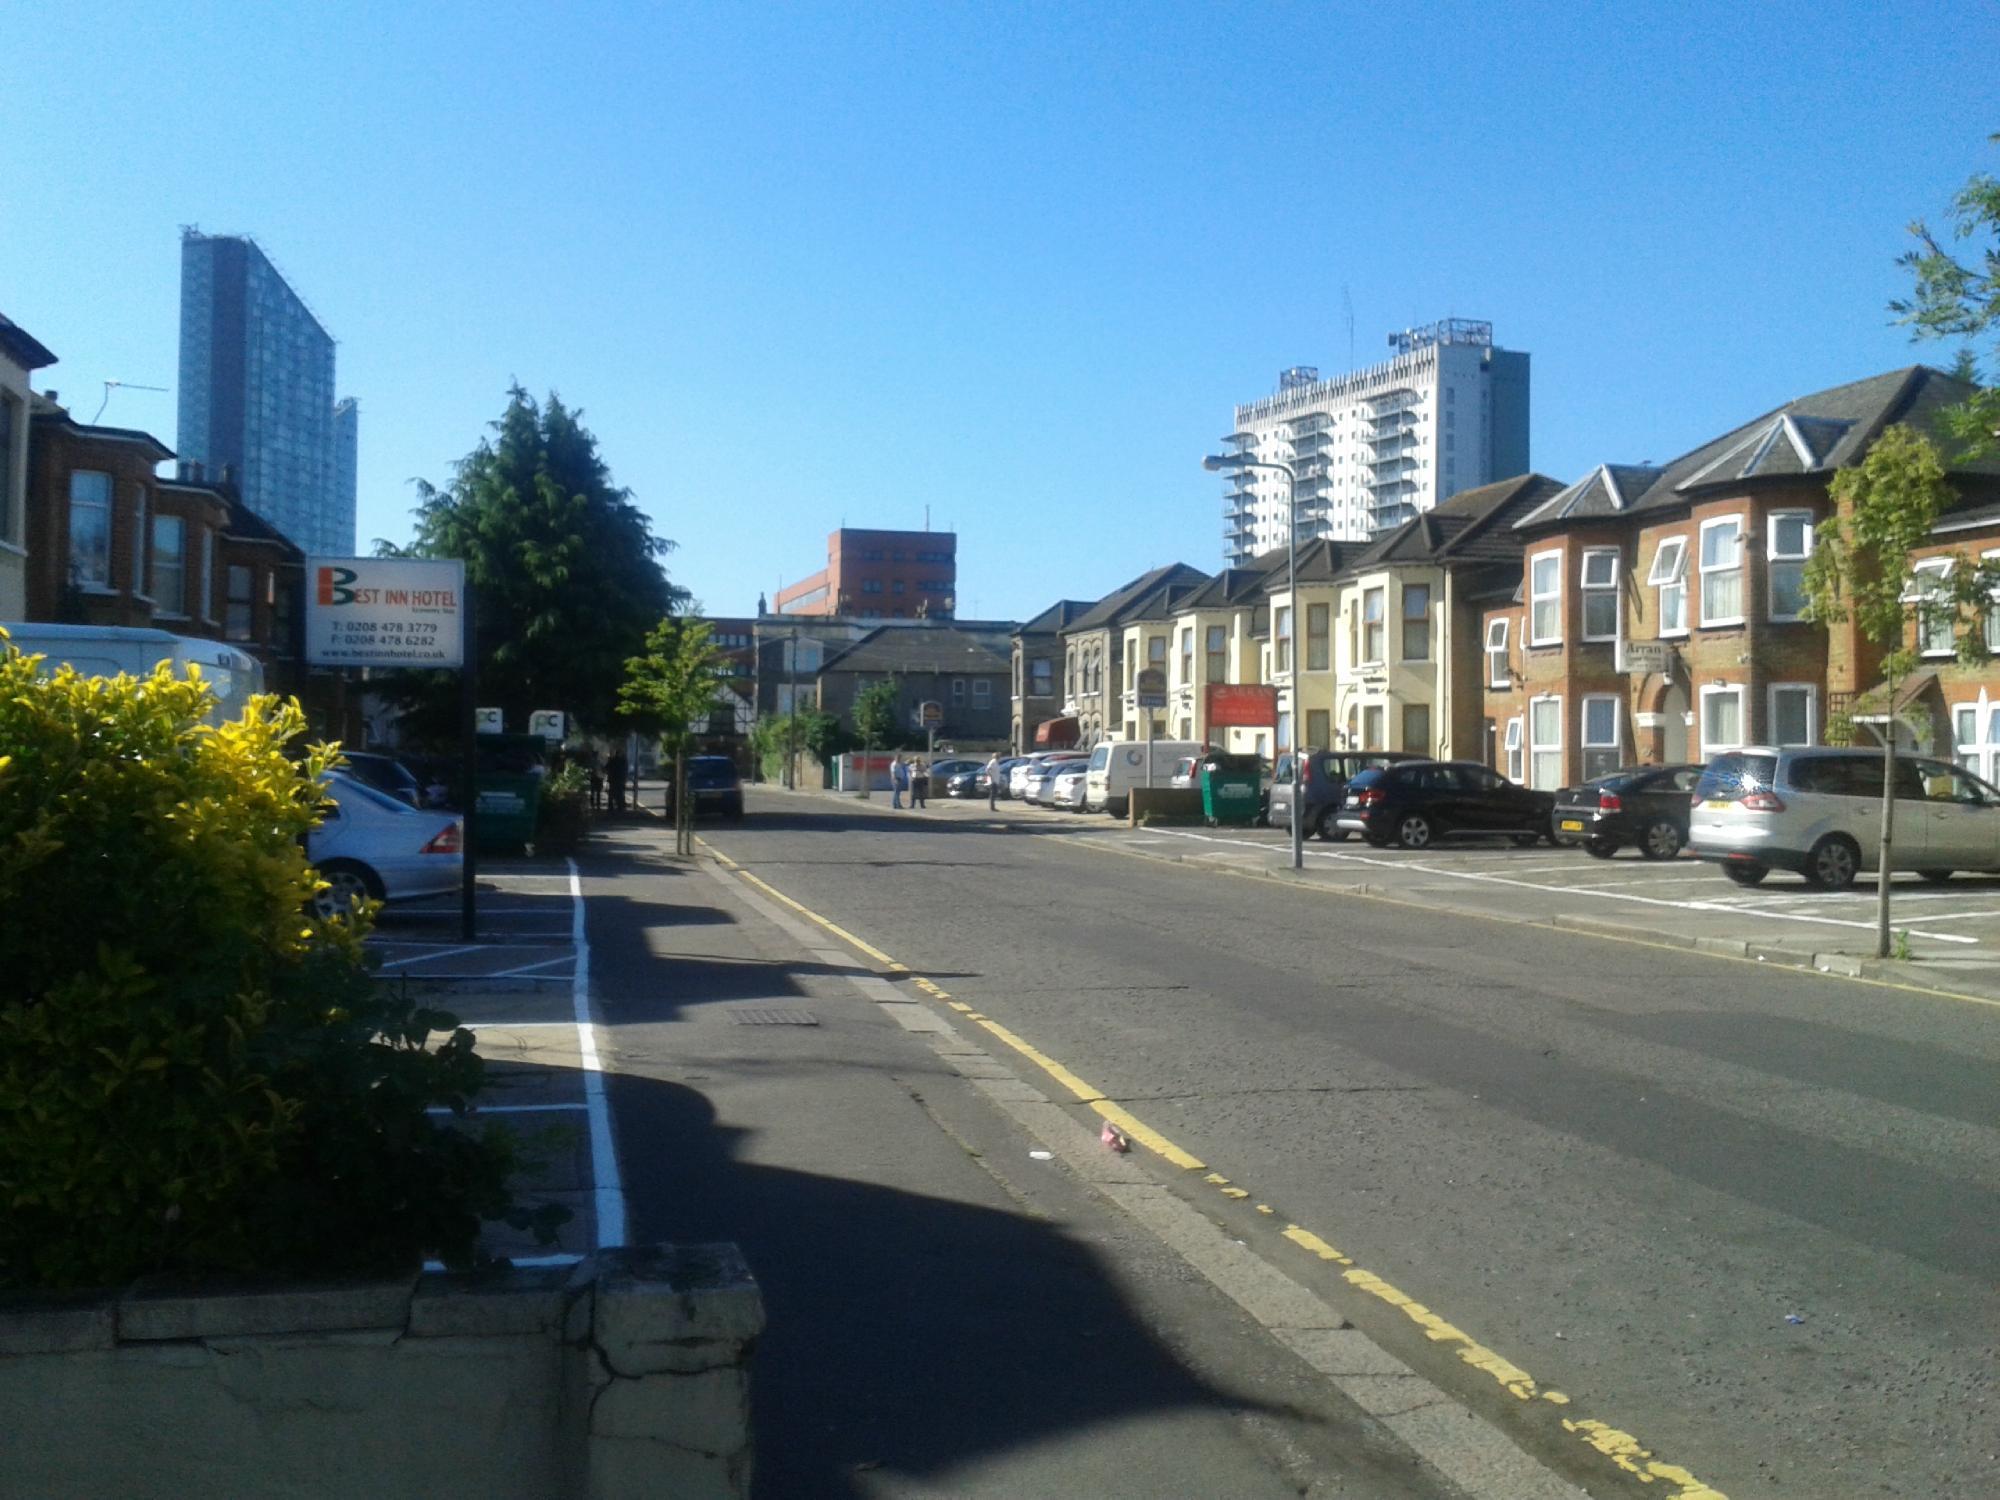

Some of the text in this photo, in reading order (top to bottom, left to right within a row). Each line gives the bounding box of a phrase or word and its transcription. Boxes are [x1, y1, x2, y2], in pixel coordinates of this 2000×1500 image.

[318, 567, 457, 607] BEST INN HOTEL
[347, 622, 377, 632] 0208
[381, 622, 403, 632] 478
[408, 623, 437, 633] 3779
[345, 635, 375, 645] 0208
[380, 635, 402, 645] 478
[405, 635, 435, 646] 6282
